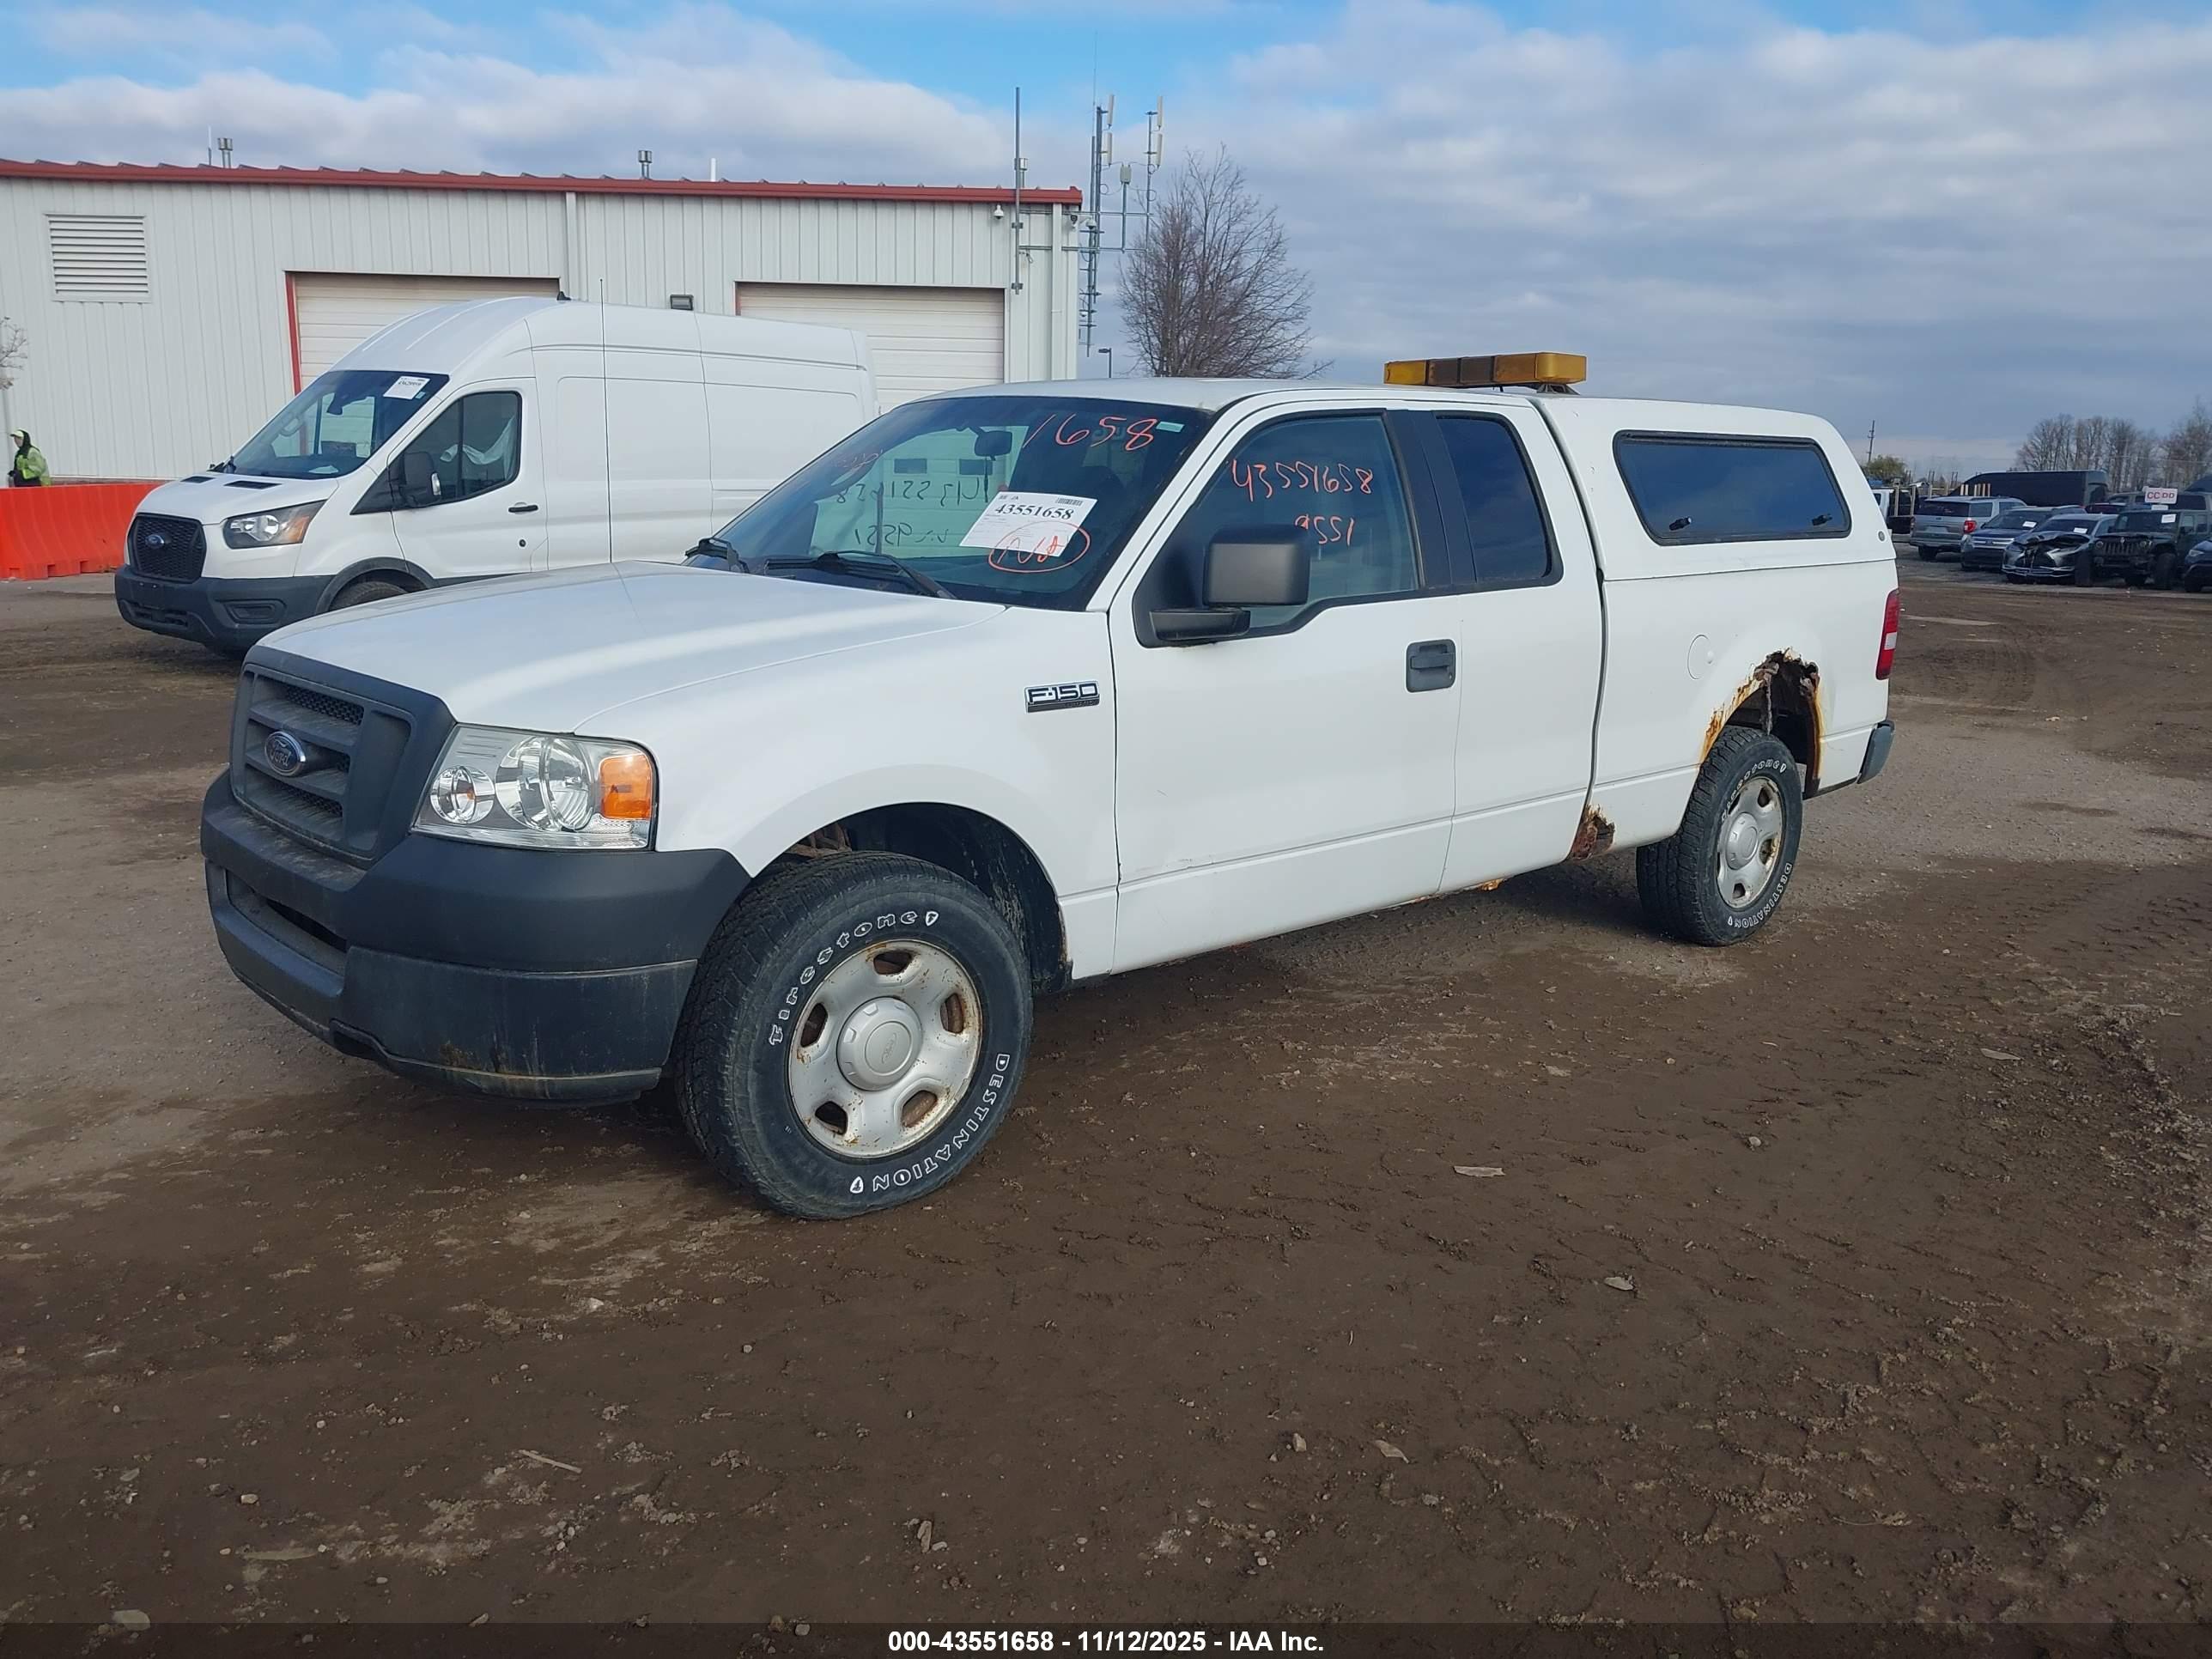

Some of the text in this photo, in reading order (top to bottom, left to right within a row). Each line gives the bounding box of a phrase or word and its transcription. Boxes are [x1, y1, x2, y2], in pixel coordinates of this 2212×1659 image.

[1022, 413, 1158, 451] 1658
[1231, 459, 1374, 502] 43551658
[994, 503, 1074, 520] 43551658
[1027, 683, 1099, 703] F-150
[269, 738, 293, 768] Ford
[769, 910, 918, 1045] Firestone
[872, 1053, 1011, 1193] DESTINATION
